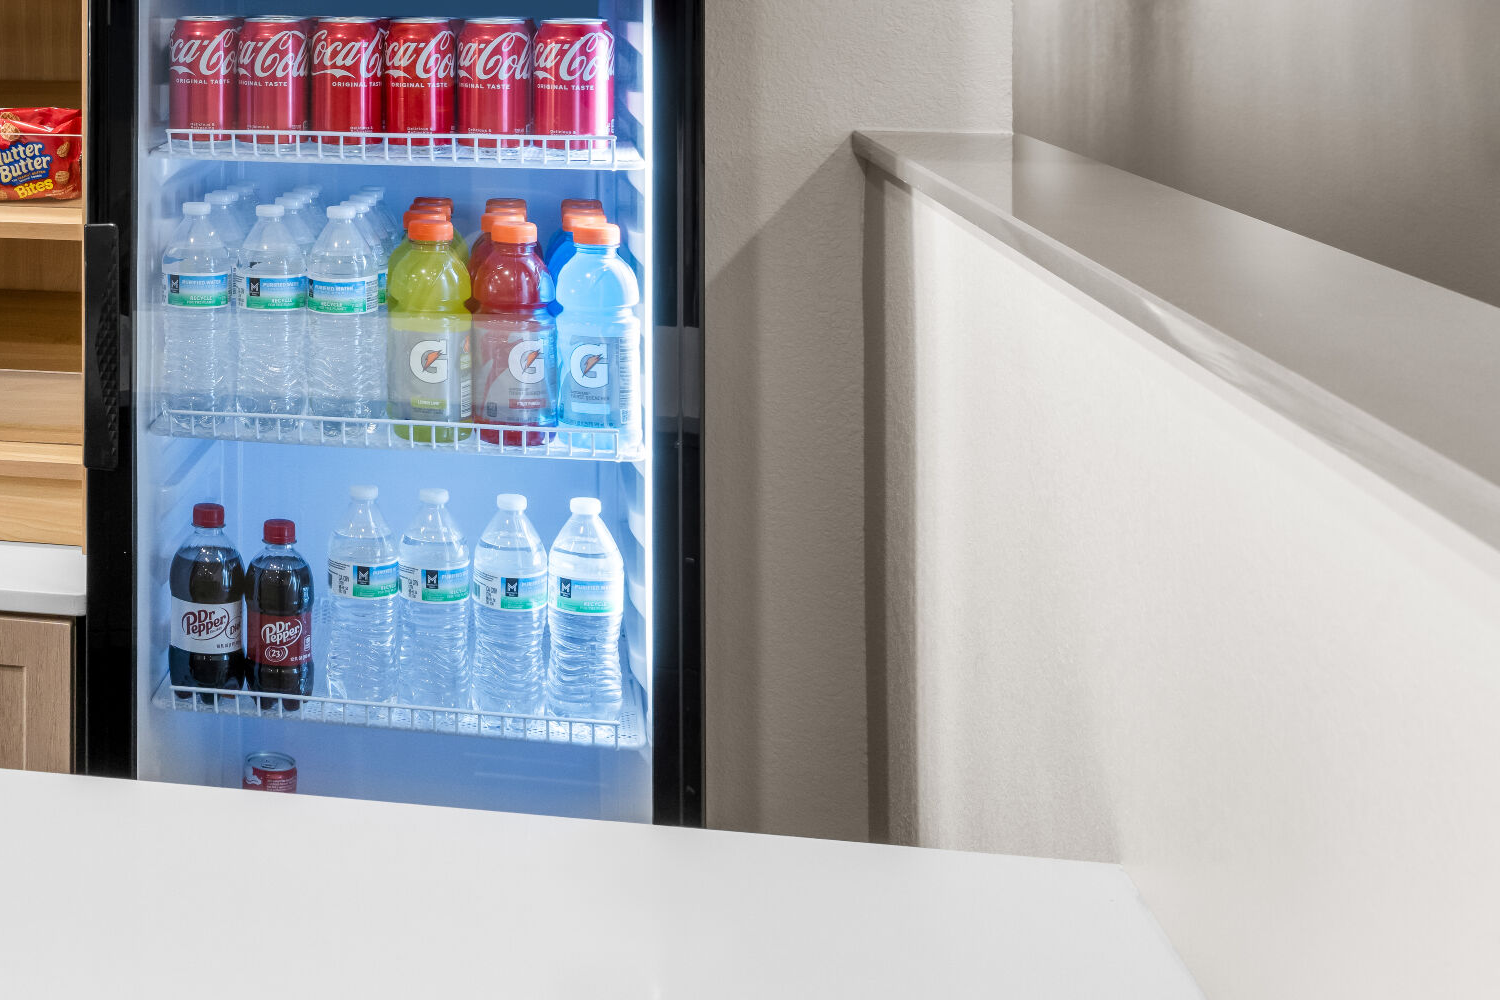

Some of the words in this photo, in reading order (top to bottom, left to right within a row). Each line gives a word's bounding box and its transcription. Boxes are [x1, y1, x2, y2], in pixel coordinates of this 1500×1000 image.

[14, 178, 54, 199] Bites
[409, 339, 448, 384] G
[508, 338, 545, 384] G
[570, 343, 610, 389] G
[182, 610, 227, 636] Pepper
[197, 609, 215, 622] Dr
[276, 620, 291, 630] Dr
[261, 621, 301, 645] Pepper
[271, 649, 280, 658] 23
